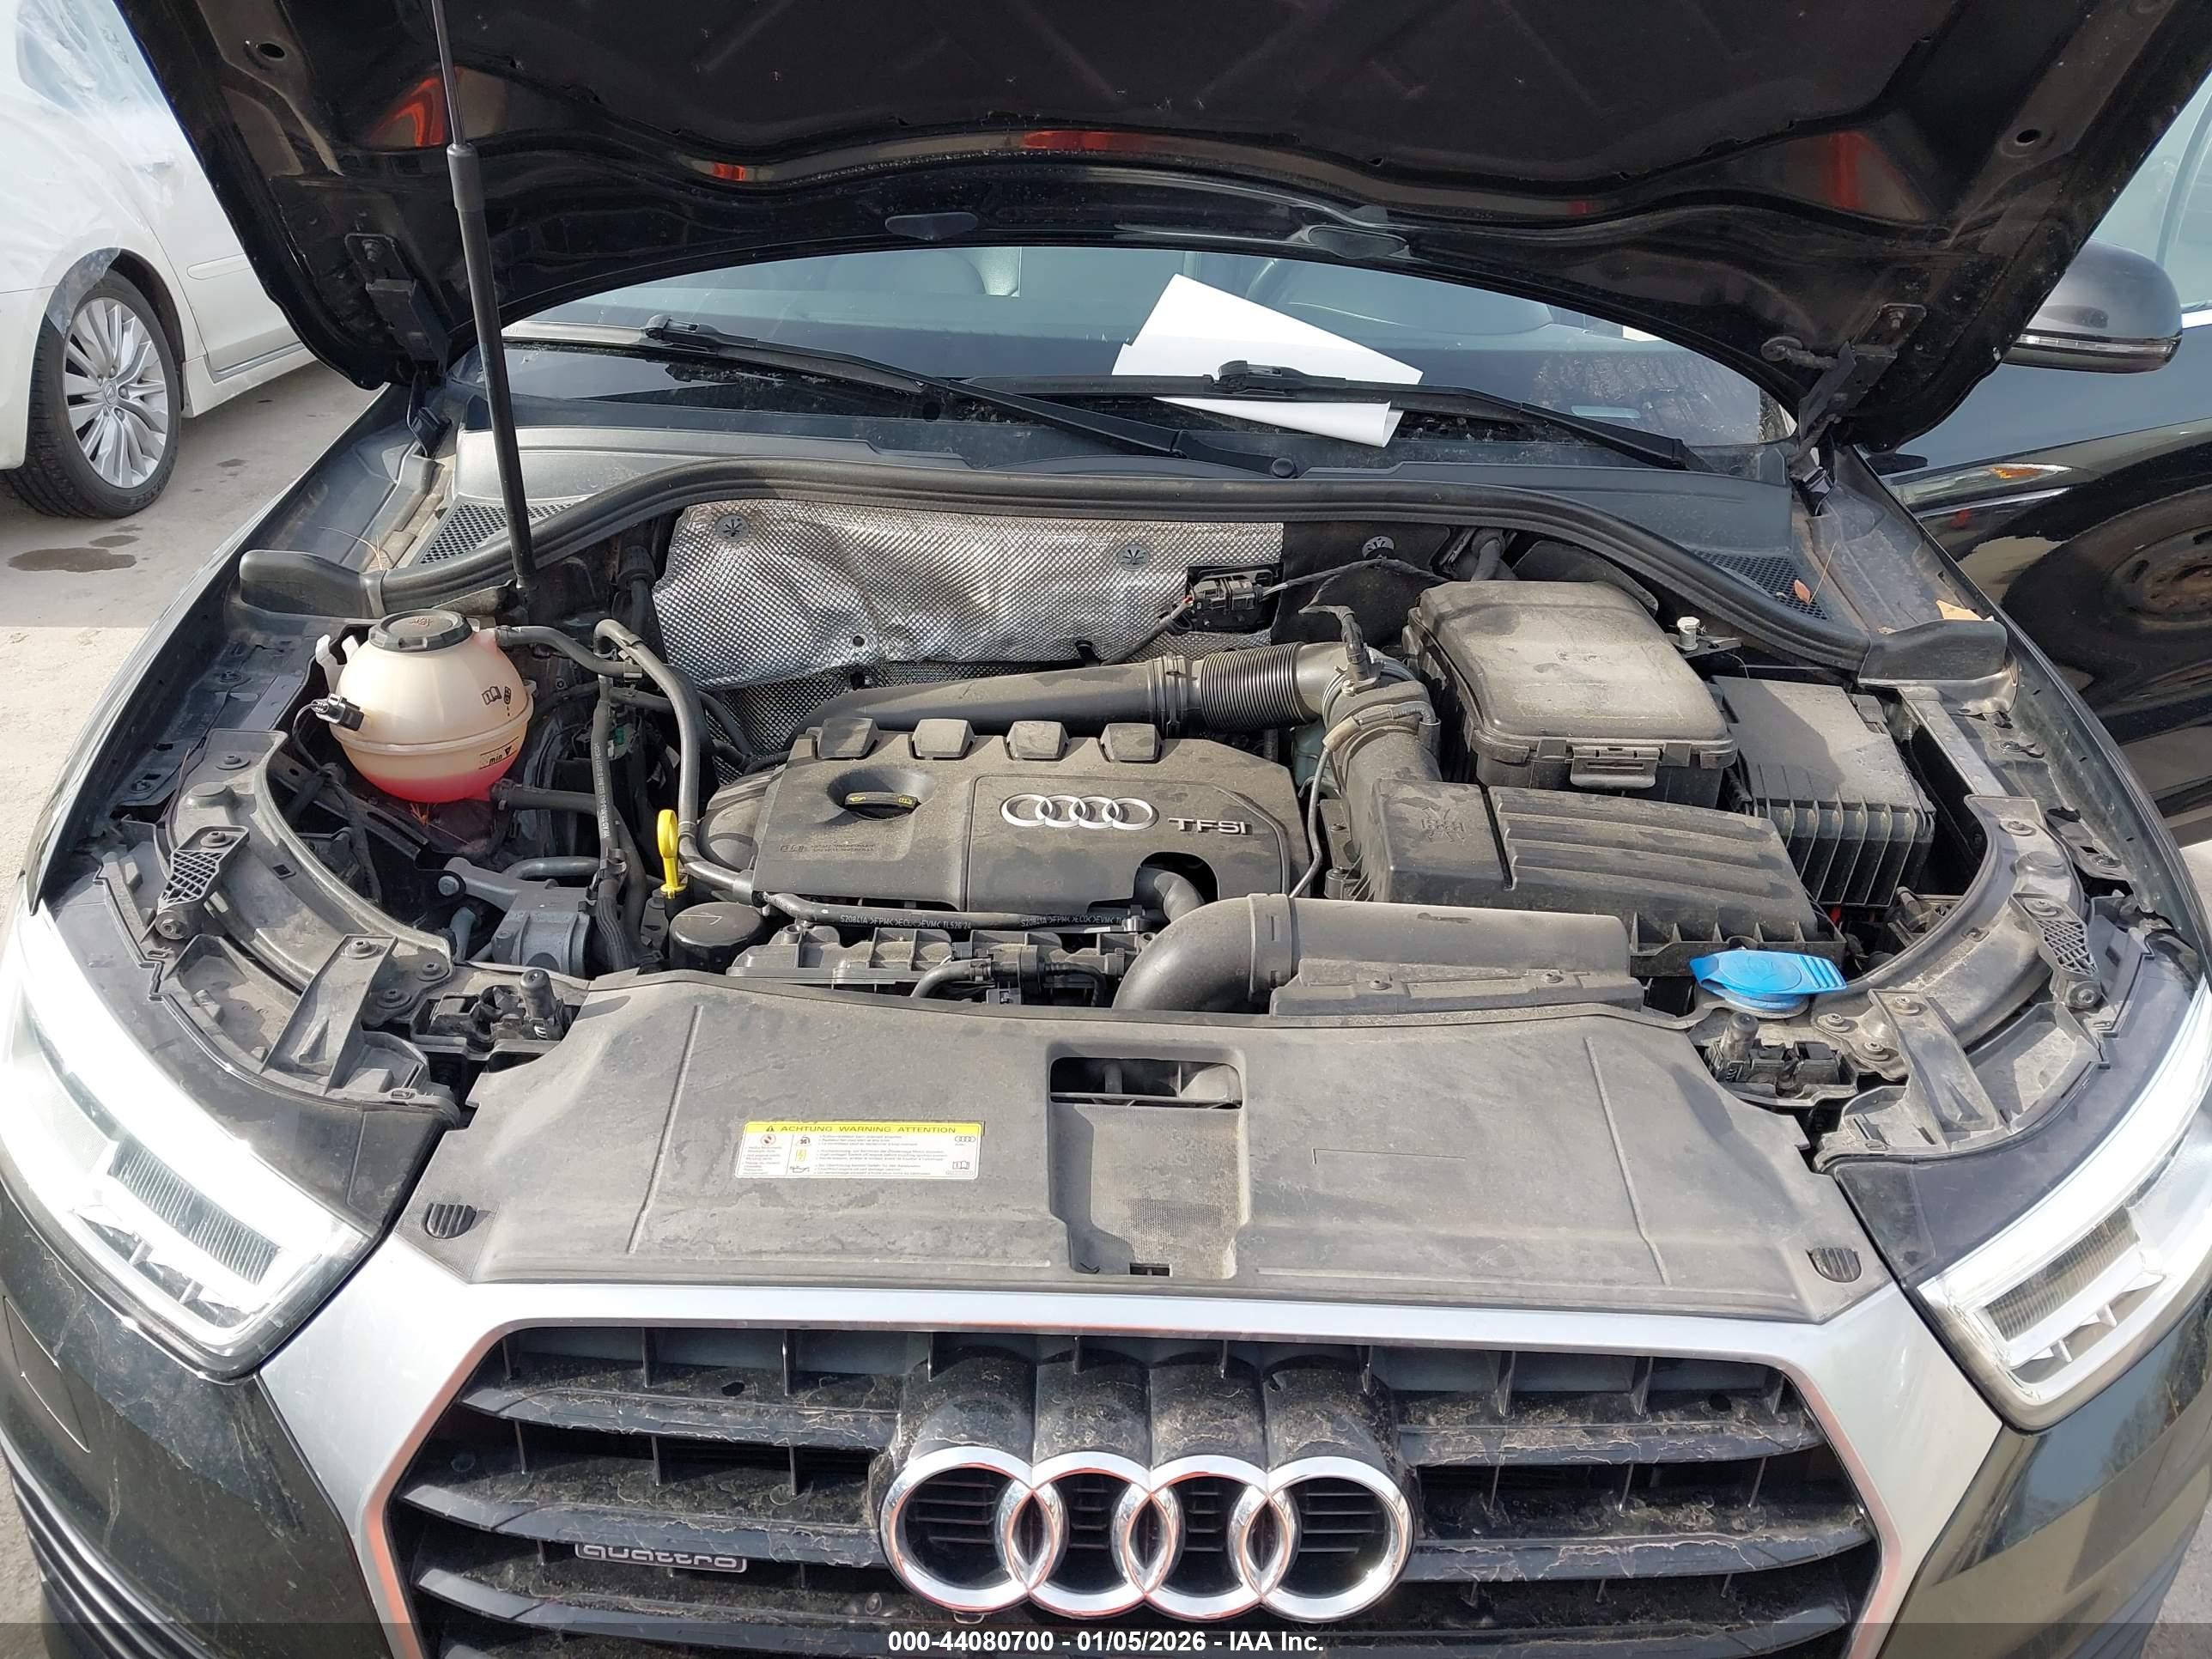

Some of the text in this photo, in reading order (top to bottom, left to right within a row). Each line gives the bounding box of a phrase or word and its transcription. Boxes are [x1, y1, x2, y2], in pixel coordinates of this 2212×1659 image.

[489, 754, 502, 766] min
[1168, 817, 1246, 835] TFSI
[583, 1545, 737, 1568] quattro
